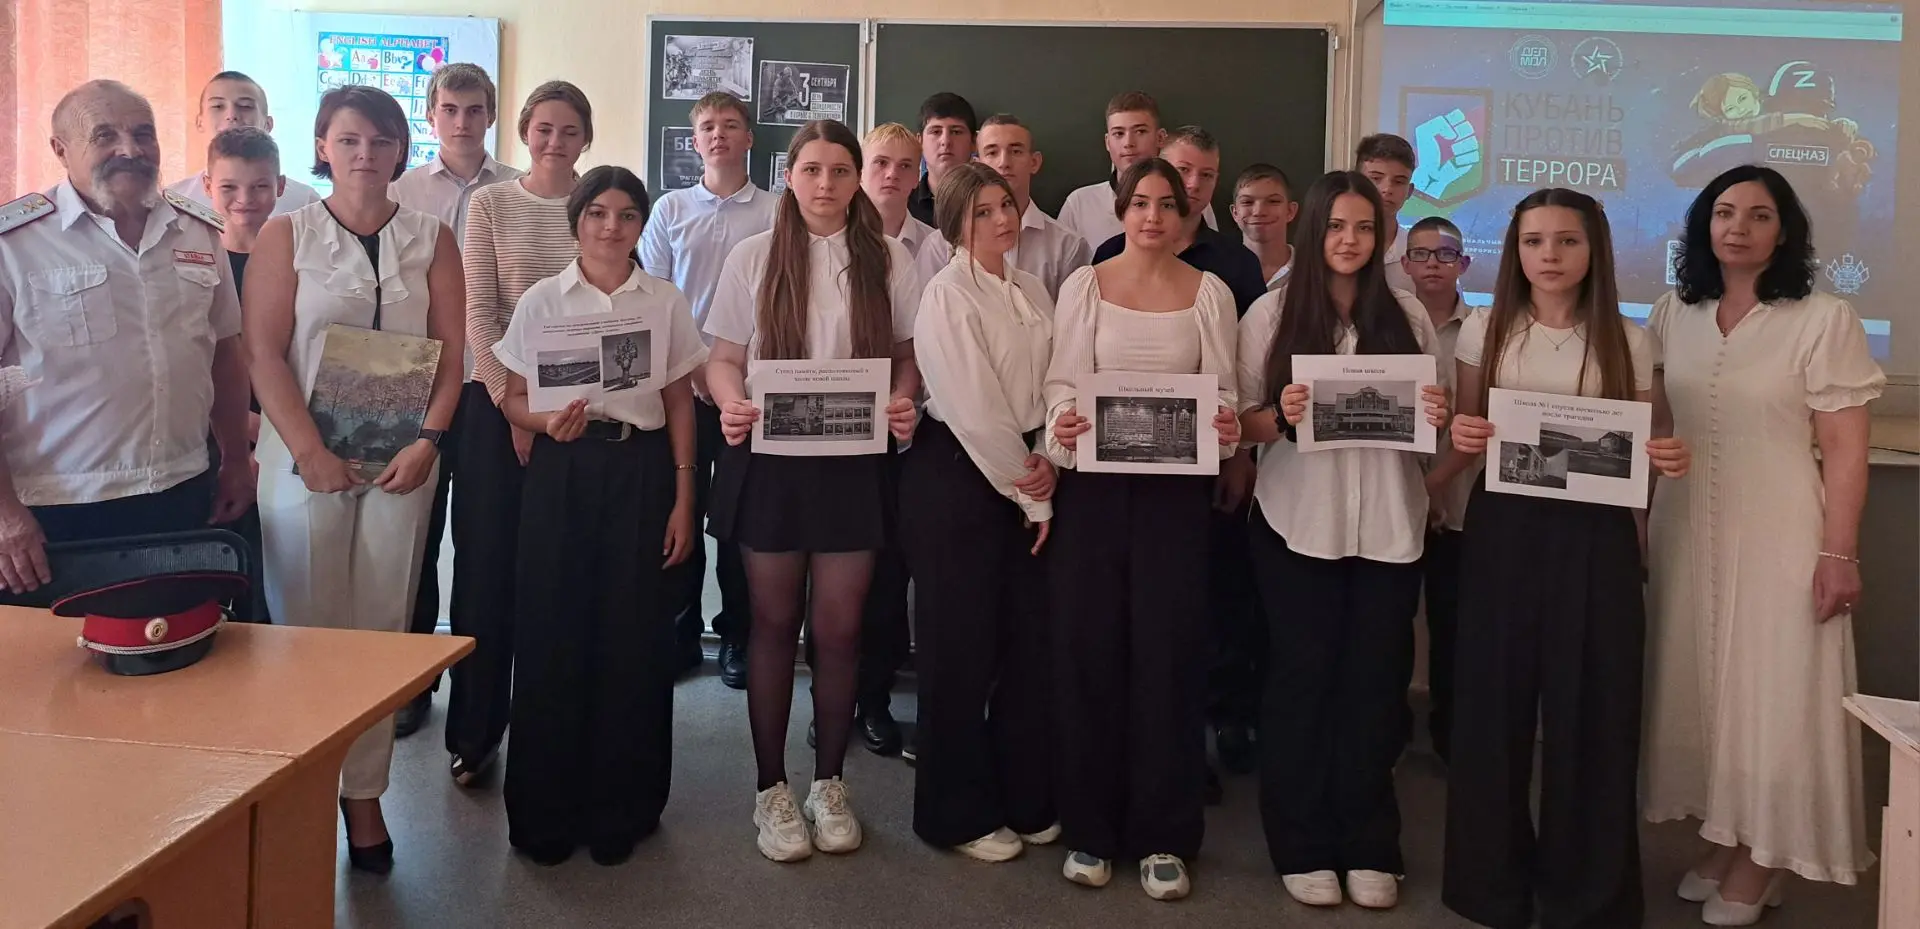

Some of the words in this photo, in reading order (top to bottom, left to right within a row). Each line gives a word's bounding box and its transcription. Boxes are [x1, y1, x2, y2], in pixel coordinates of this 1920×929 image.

[329, 35, 377, 46] ENGLISH
[382, 37, 439, 48] ALPHABET
[352, 50, 366, 63] Aa
[1792, 70, 1816, 88] Z
[799, 73, 810, 107] 3
[811, 77, 837, 88] СЕНТЯБРЯ
[1505, 91, 1624, 123] КУБАНЬ
[1504, 125, 1623, 155] ПРОТИВ
[1768, 148, 1826, 161] СПЕЦНАЗ
[1500, 158, 1618, 187] ТЕРРОРА
[1514, 399, 1537, 407] Школа
